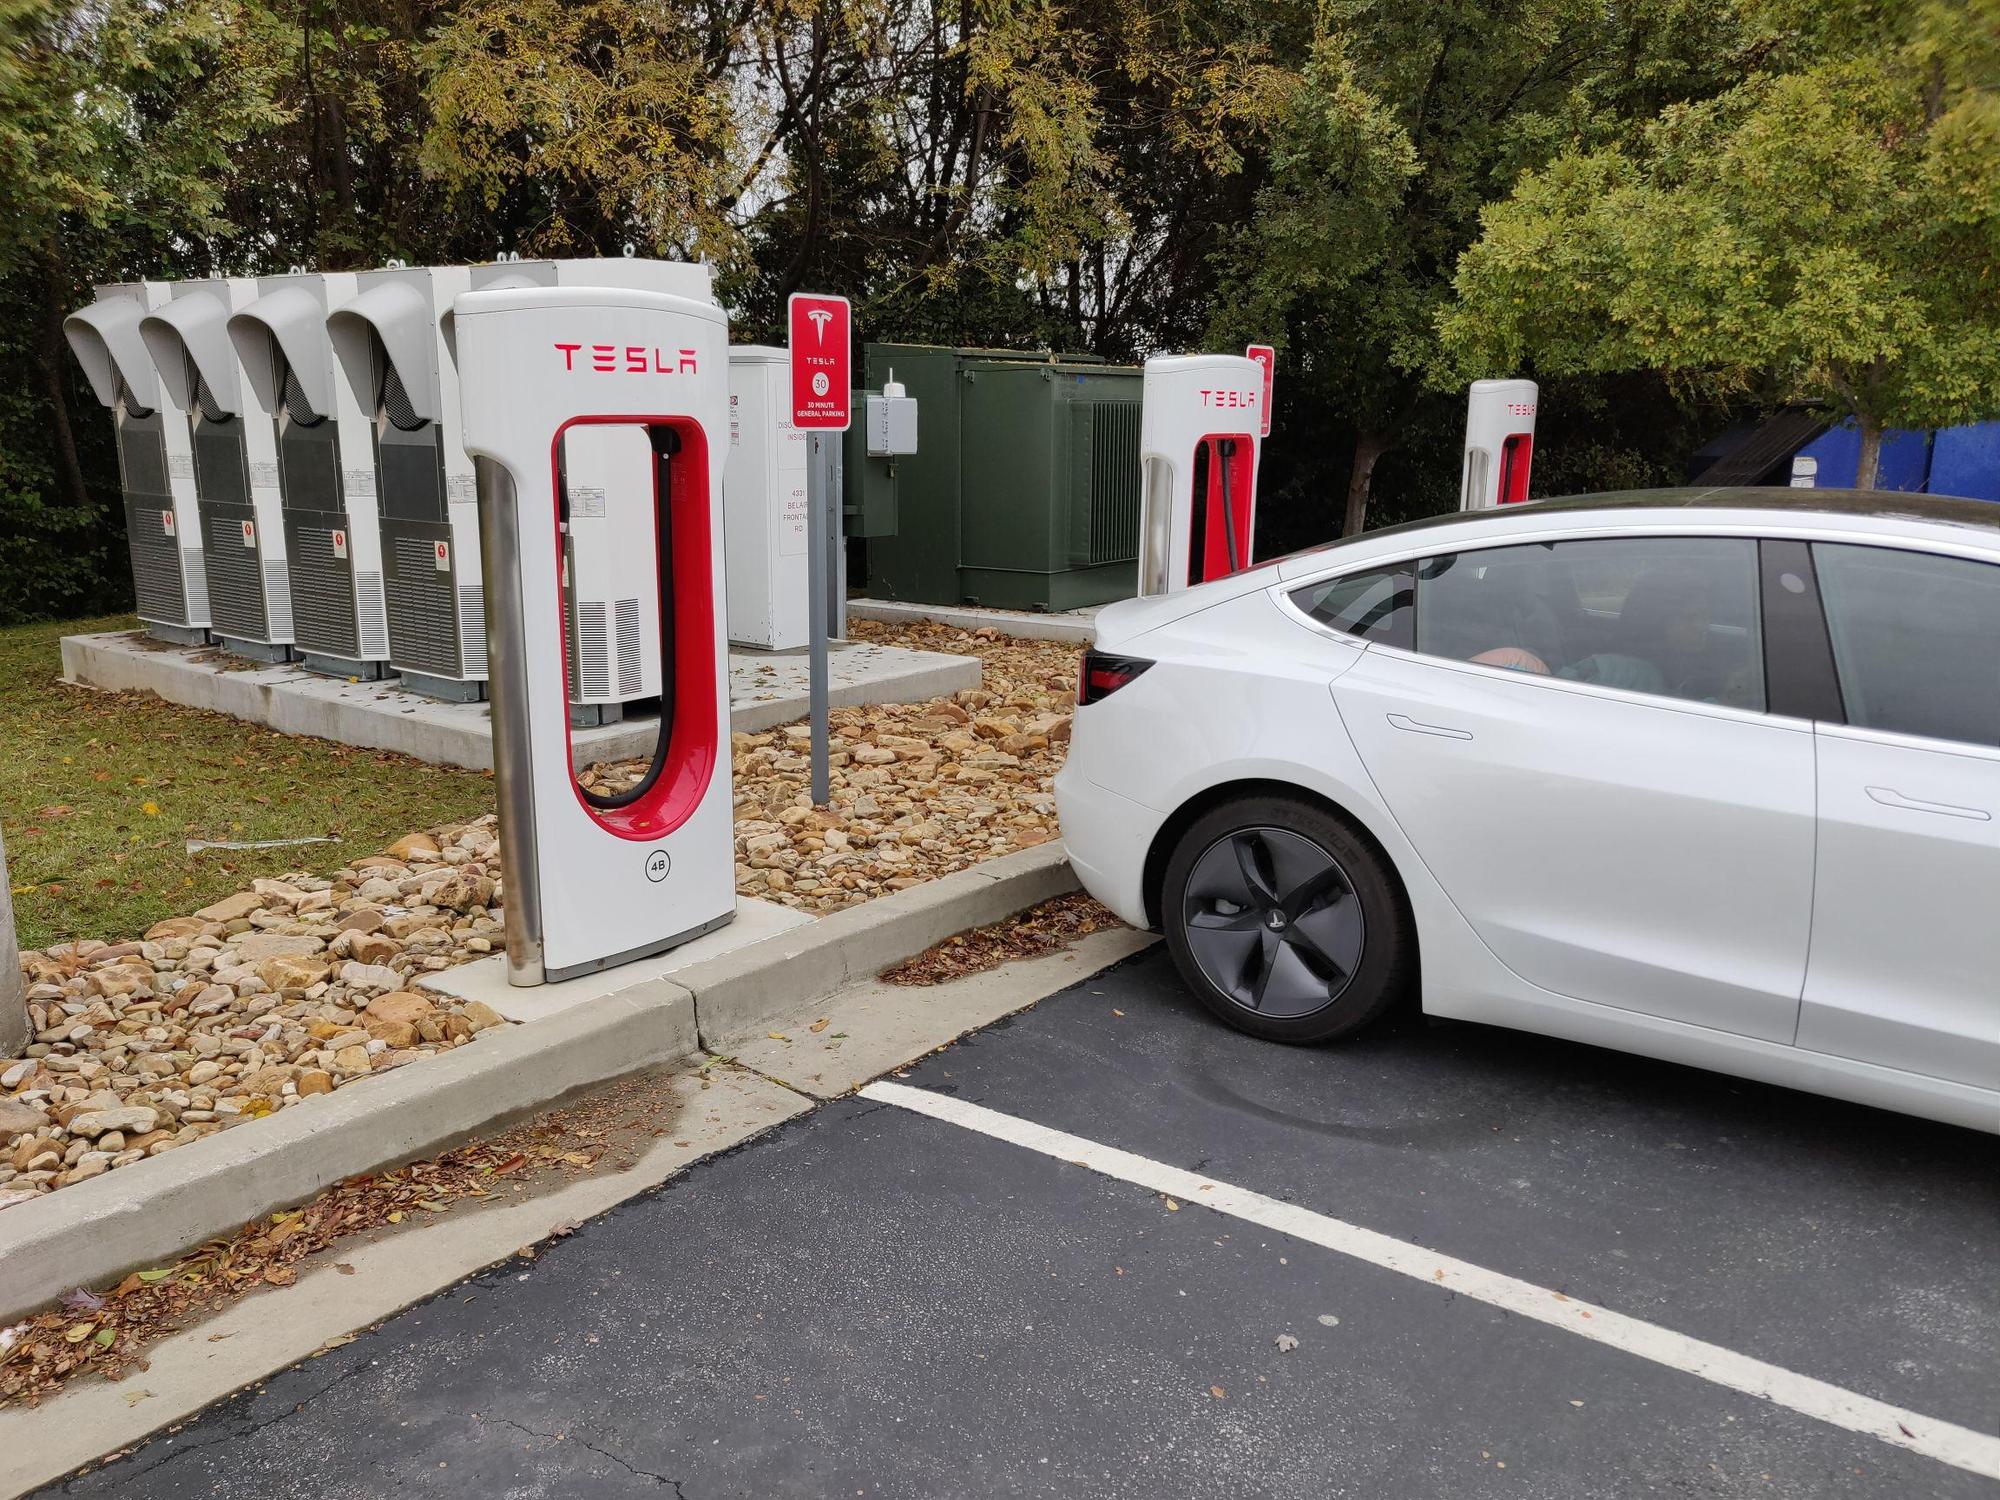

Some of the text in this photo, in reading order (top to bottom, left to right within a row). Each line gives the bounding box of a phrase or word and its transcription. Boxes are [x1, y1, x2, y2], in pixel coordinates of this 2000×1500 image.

[554, 343, 697, 375] TESLA
[806, 357, 835, 366] TESLA
[815, 379, 827, 389] 30
[1200, 390, 1255, 408] TESLA
[807, 401, 835, 409] 30 MINUTE
[1507, 404, 1535, 416] TESLA
[822, 410, 845, 418] PARKING
[651, 860, 666, 871] 4B
